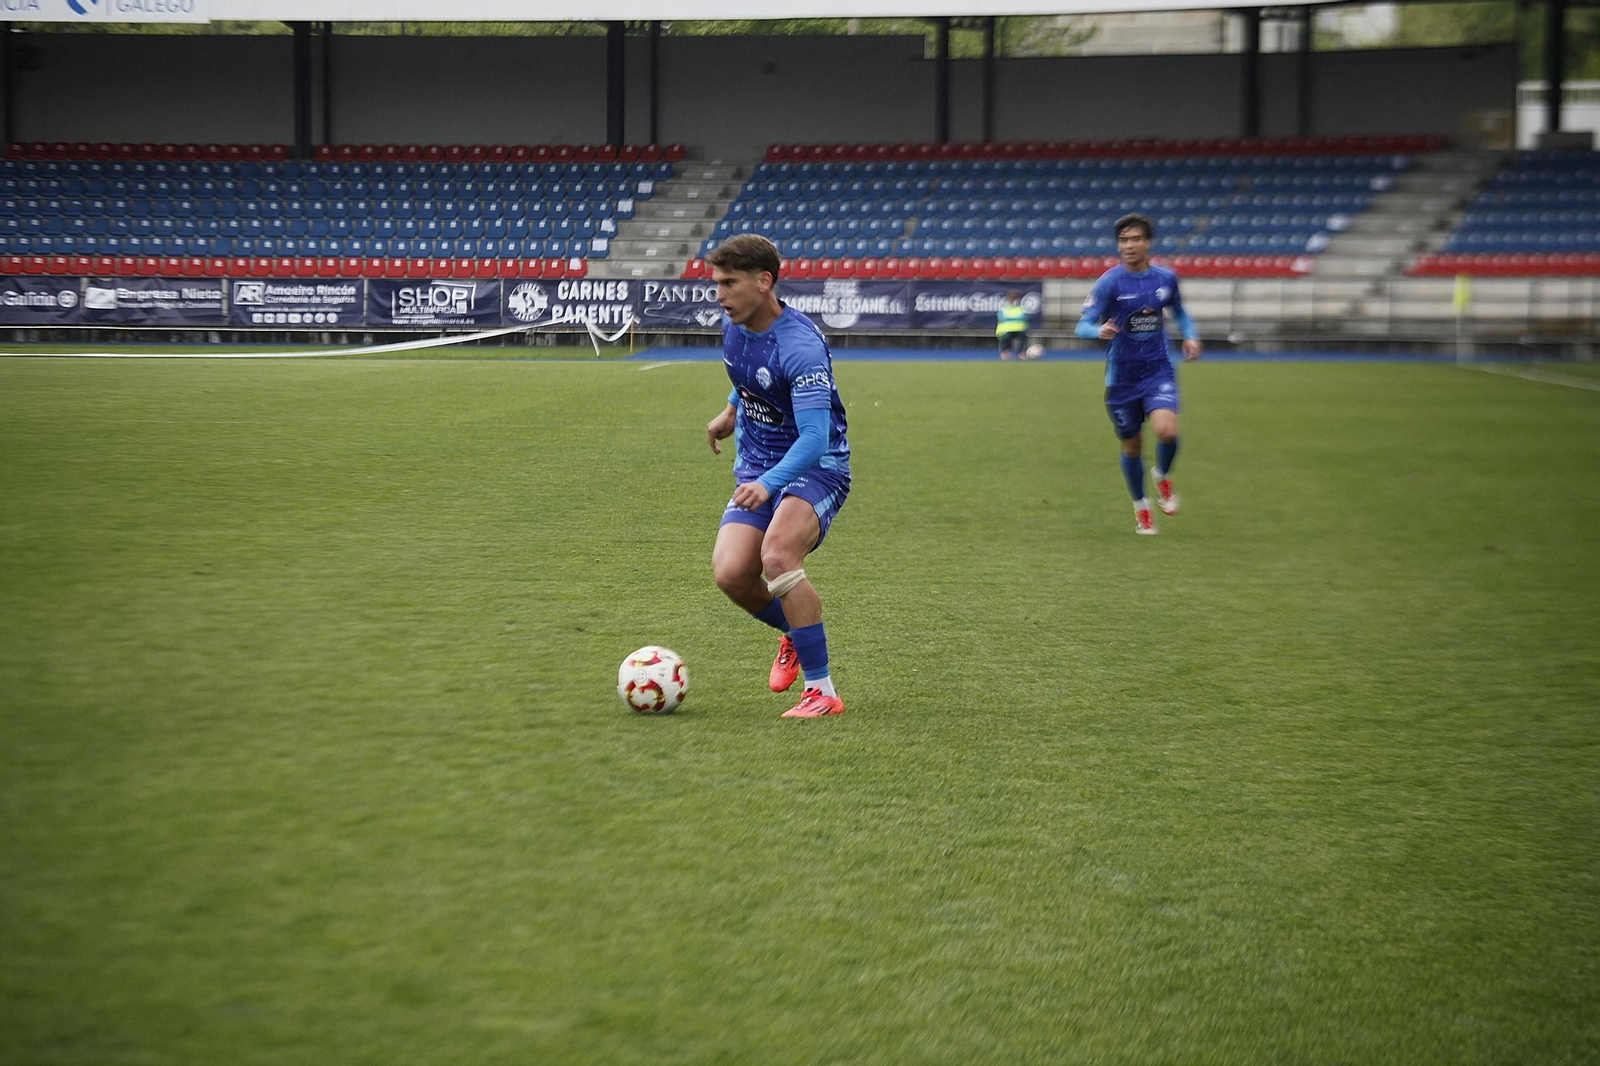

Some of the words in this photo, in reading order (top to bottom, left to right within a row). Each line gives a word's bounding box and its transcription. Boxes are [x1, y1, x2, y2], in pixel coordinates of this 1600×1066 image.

[117, 288, 179, 301] Empresa
[181, 288, 222, 299] Nieto
[236, 284, 264, 302] AR
[398, 286, 468, 307] SHOP
[558, 281, 628, 300] CARNES
[400, 305, 456, 314] MULTIMARCA
[914, 292, 968, 311] Estrella
[552, 304, 633, 324] PARENTE
